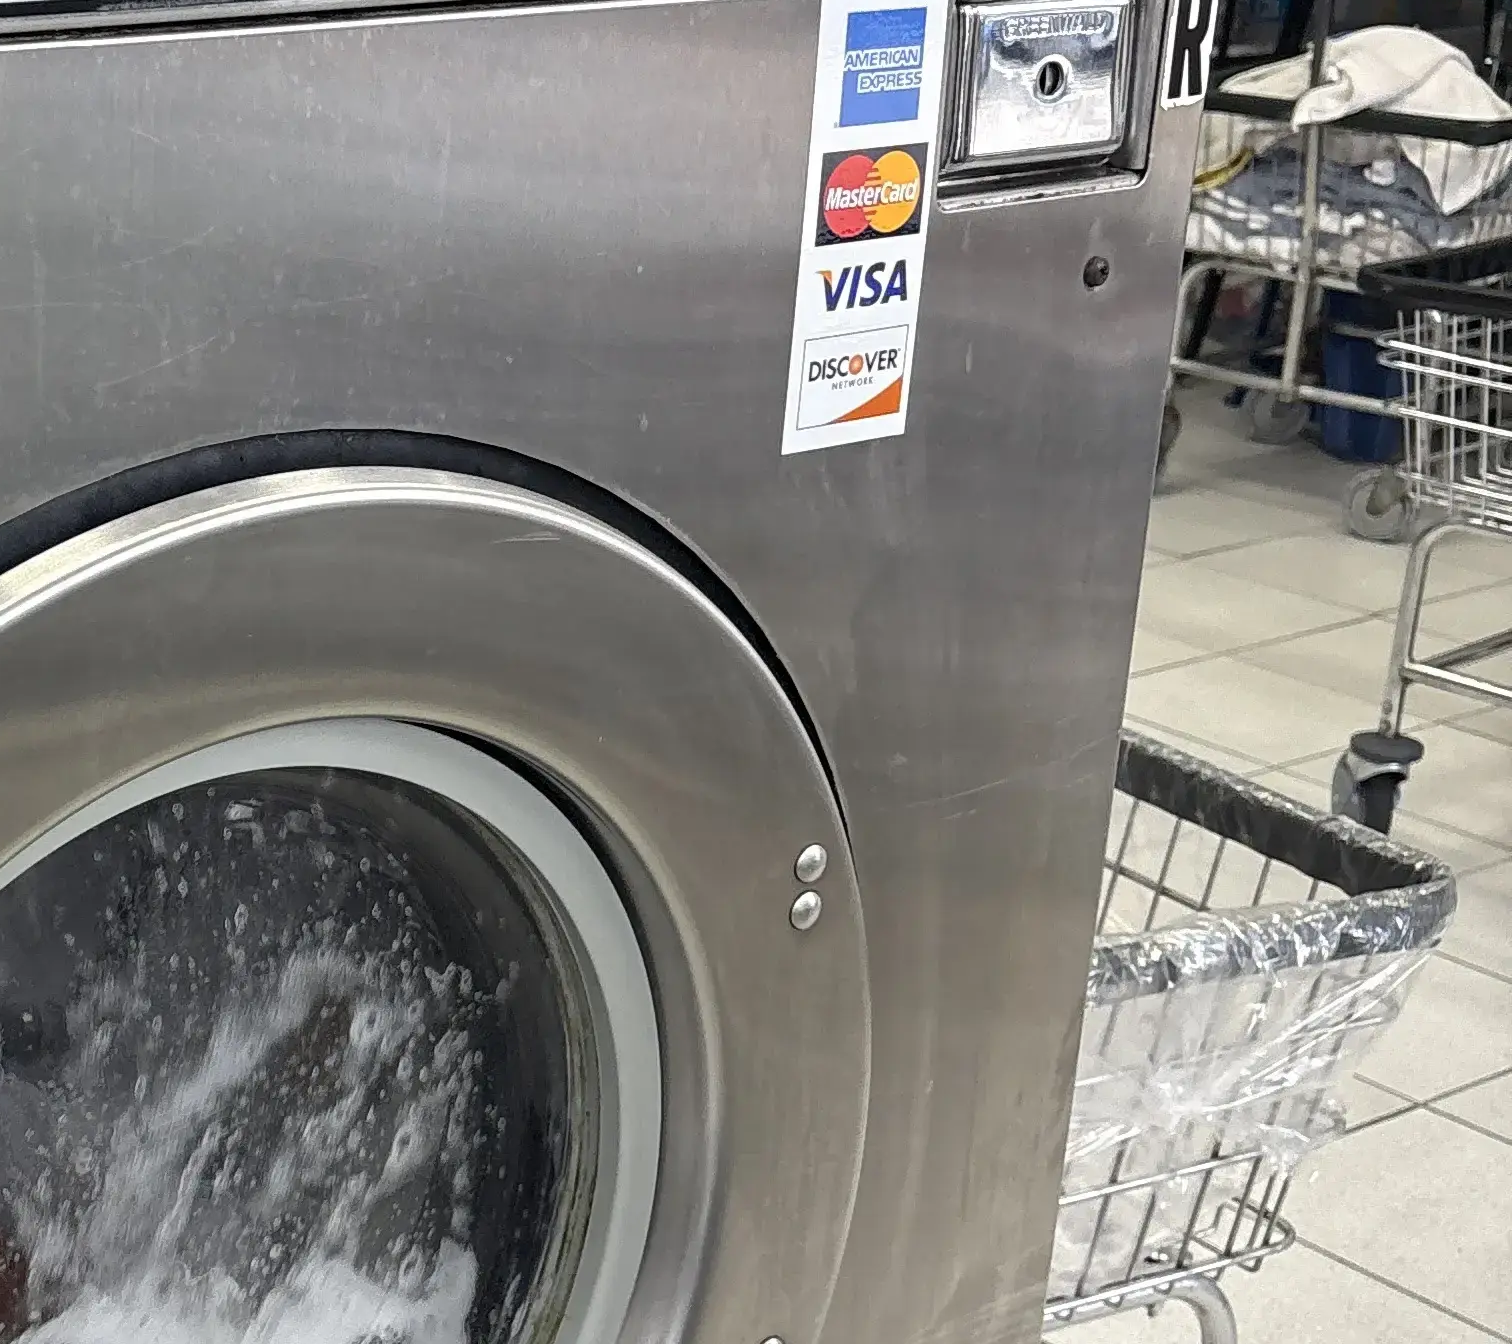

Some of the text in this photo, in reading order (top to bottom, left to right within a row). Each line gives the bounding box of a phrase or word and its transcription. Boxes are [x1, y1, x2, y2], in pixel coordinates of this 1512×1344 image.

[844, 48, 919, 69] AMERICAN
[859, 70, 923, 91] EXPRESS
[825, 177, 919, 211] MasterCard
[815, 258, 908, 312] VISA
[808, 348, 901, 382] DISCOVER
[831, 376, 874, 391] NETWORK
